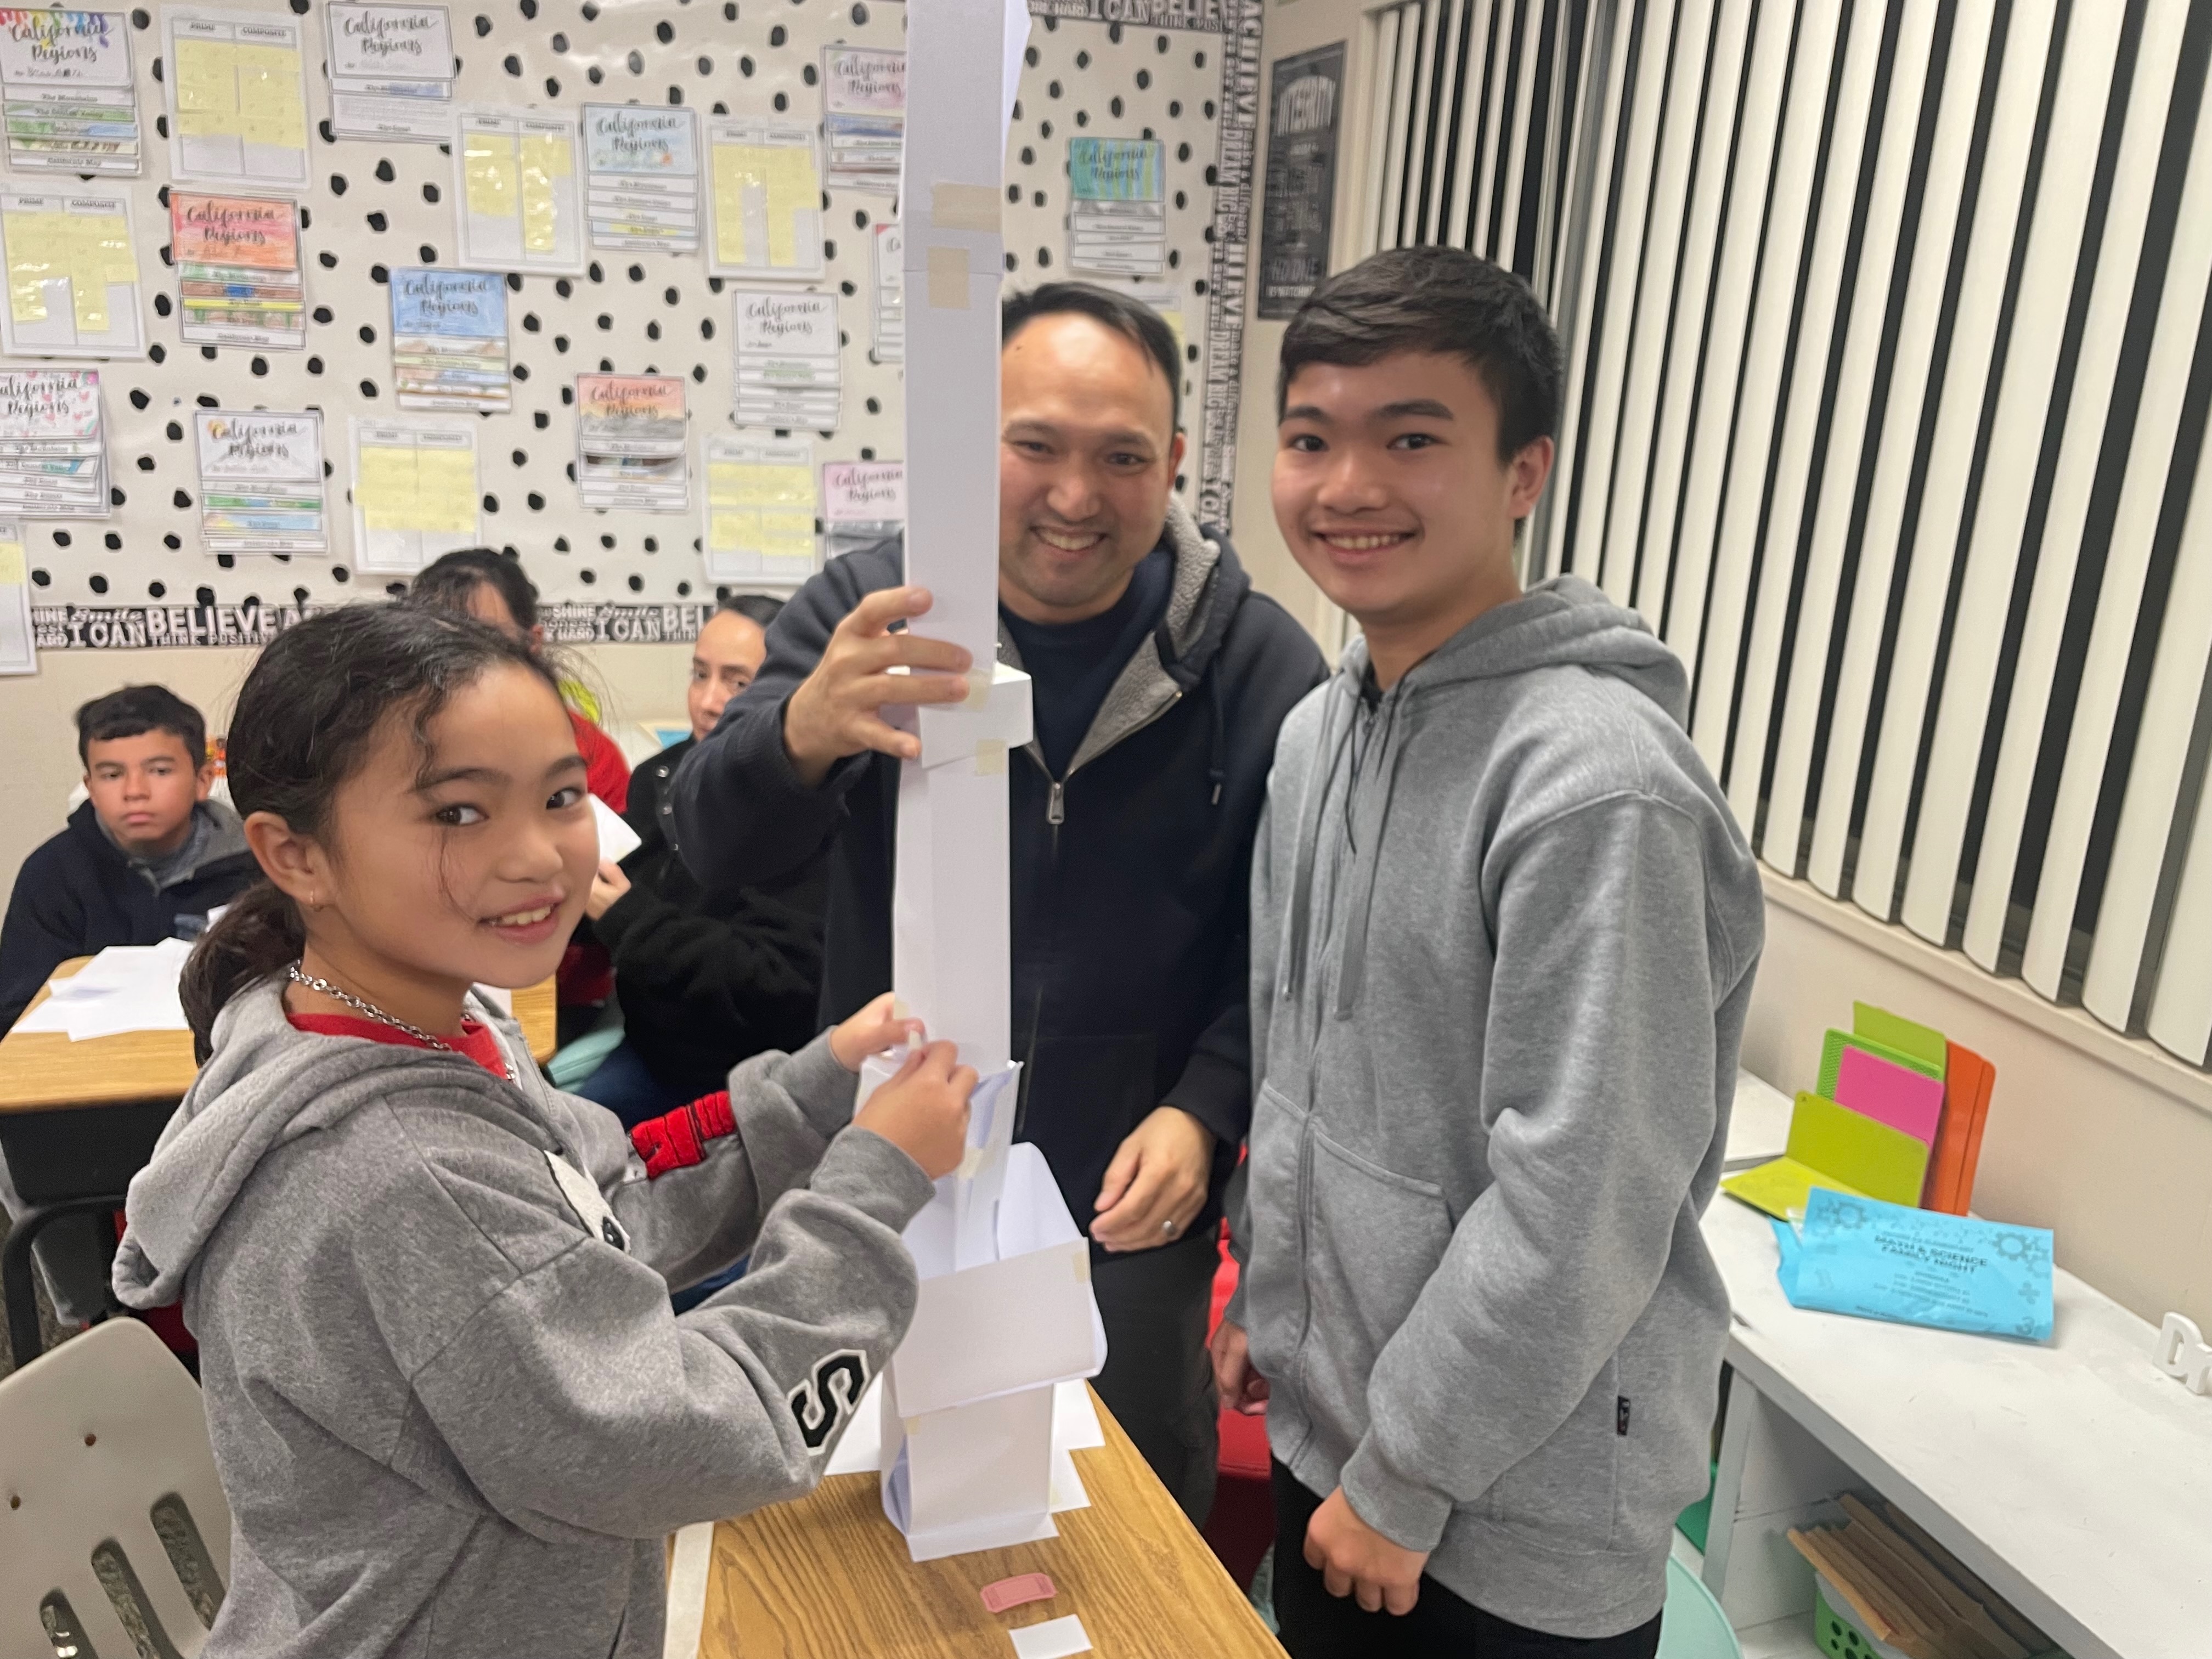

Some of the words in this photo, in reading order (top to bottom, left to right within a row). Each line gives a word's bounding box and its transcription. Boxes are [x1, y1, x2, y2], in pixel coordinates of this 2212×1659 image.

[12, 14, 114, 46] California
[345, 10, 438, 38] California
[1218, 129, 1243, 183] DREAM
[1216, 187, 1239, 212] BIG
[188, 200, 277, 228] California
[404, 273, 487, 301] California
[746, 296, 828, 322] California
[1210, 330, 1231, 380] DREAM
[0, 375, 78, 400] alifornia
[1207, 383, 1228, 407] BIG
[8, 400, 69, 421] Regions
[1200, 495, 1220, 528] CA
[67, 622, 87, 648] I
[89, 621, 147, 648] CAN
[145, 605, 278, 637] BELIEVE
[595, 620, 611, 642] I
[611, 617, 661, 642] CAN
[150, 633, 203, 647] THINK
[1929, 1248, 1988, 1267] SCIENCE
[788, 1349, 870, 1455] S
